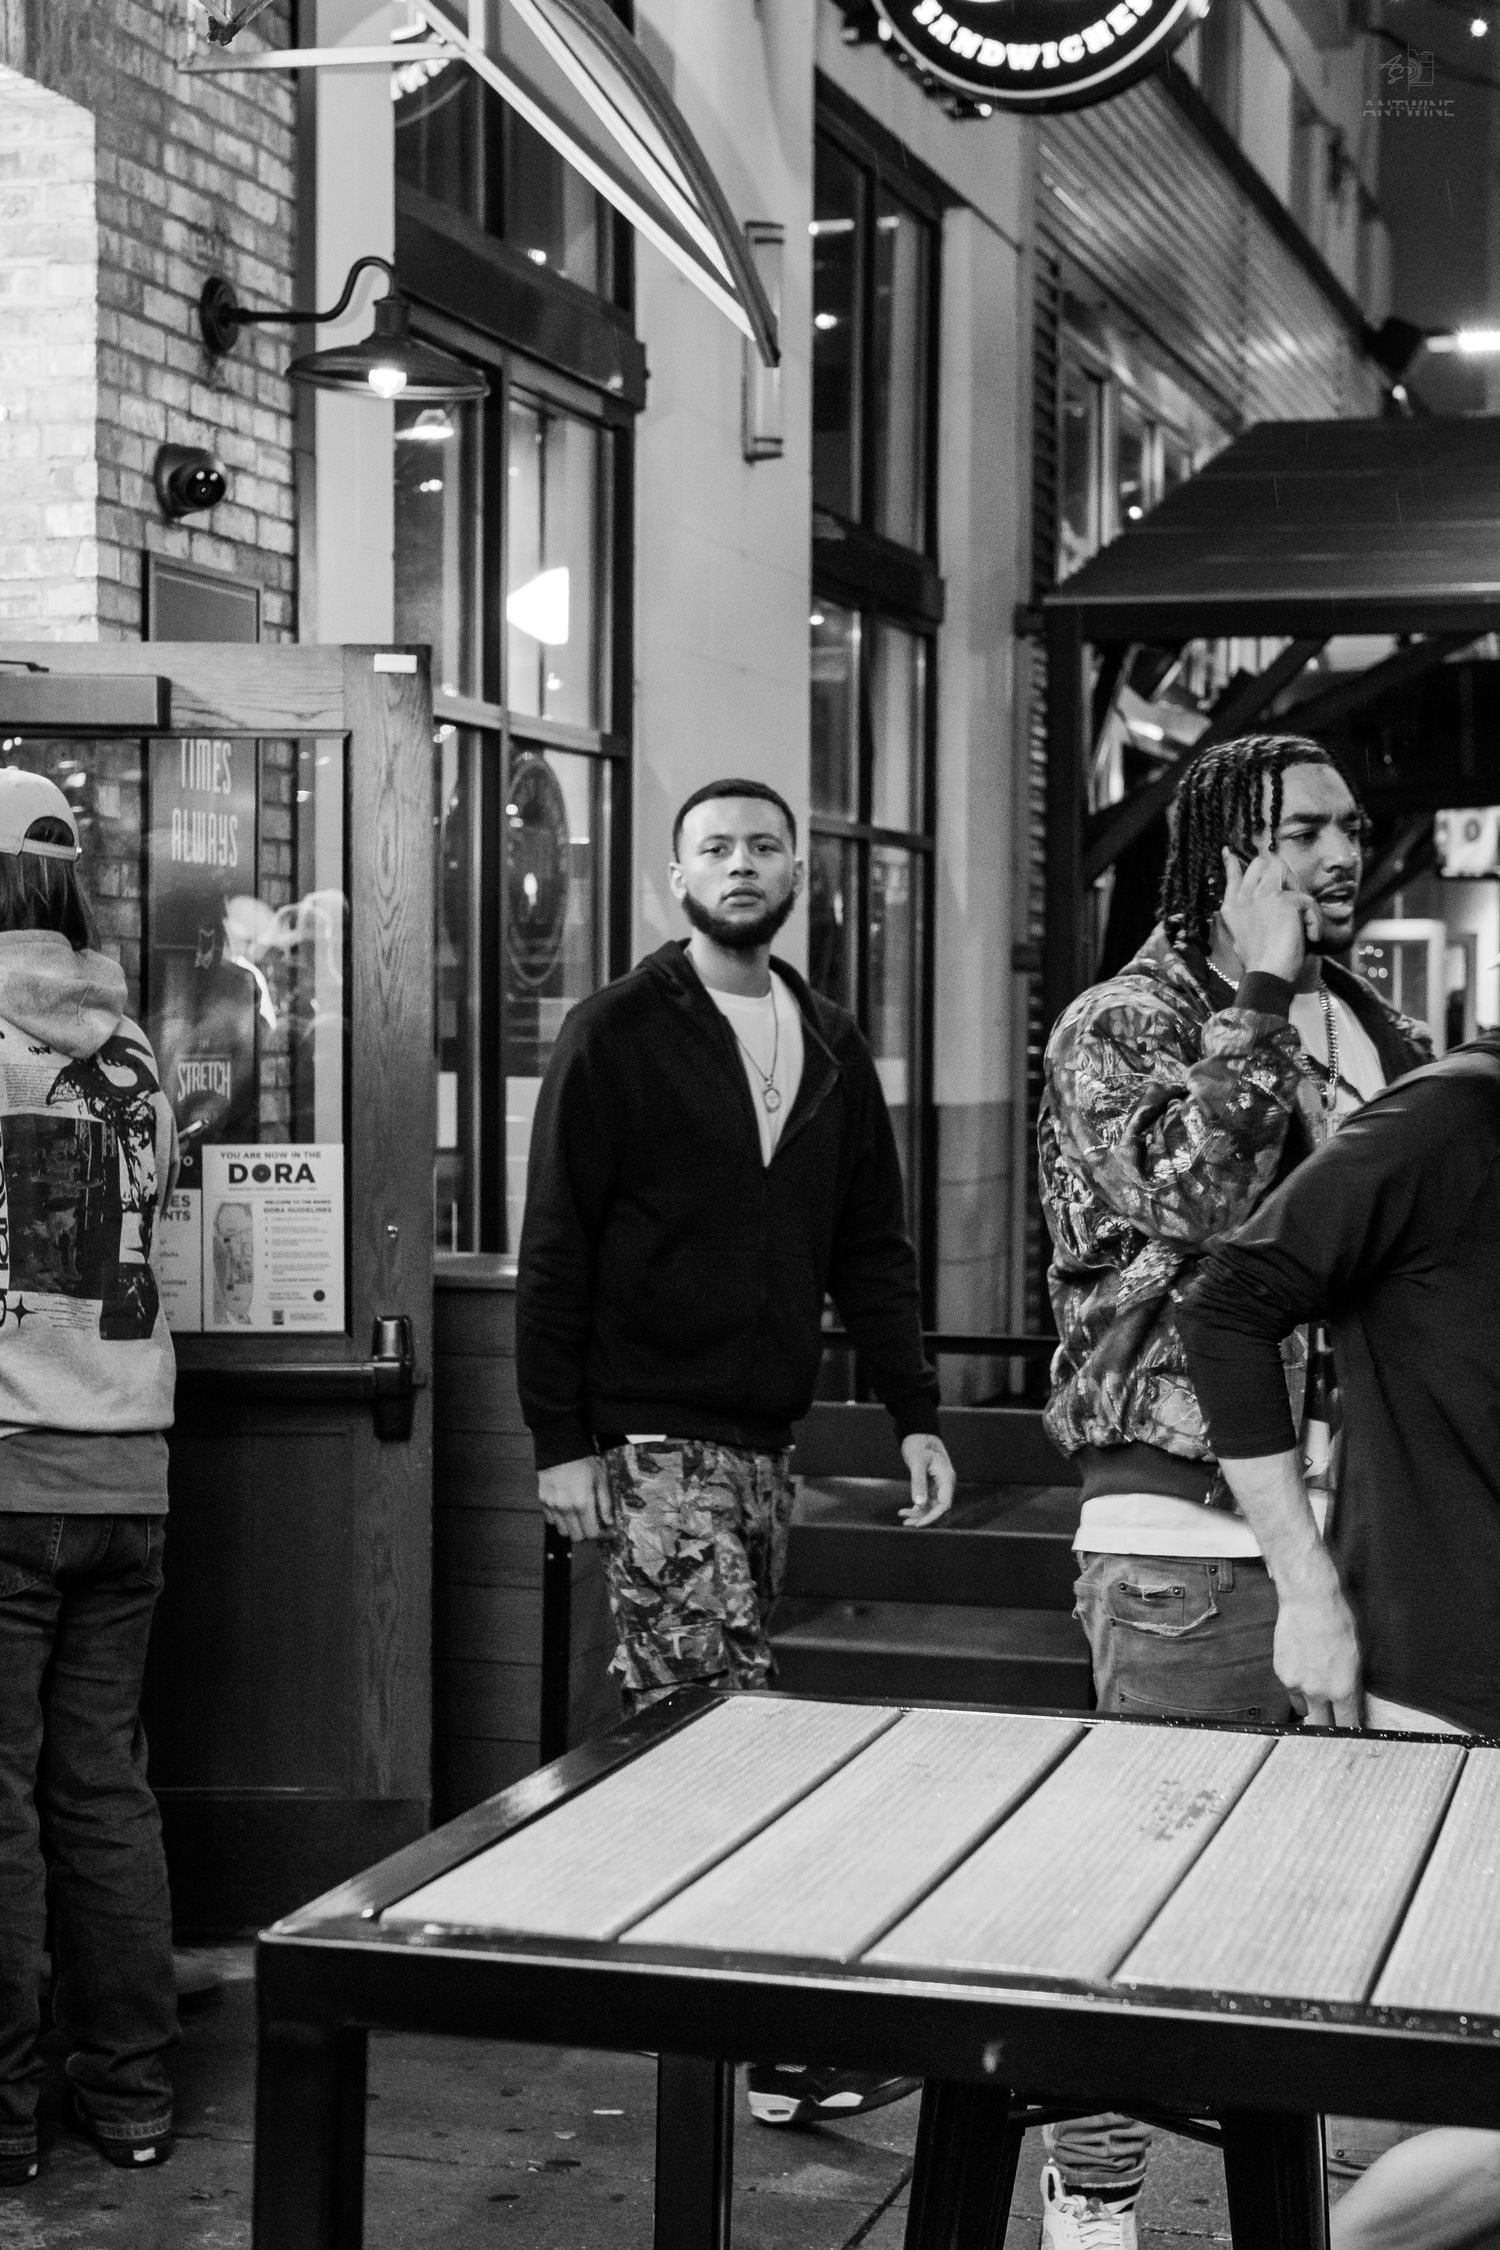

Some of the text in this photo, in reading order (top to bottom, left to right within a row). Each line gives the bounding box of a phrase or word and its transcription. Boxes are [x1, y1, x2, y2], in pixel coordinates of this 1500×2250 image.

[181, 739, 232, 795] TIMES
[172, 808, 238, 867] ALWAYS
[177, 1061, 231, 1103] STRETCH
[221, 1151, 322, 1160] YOU ARE NOW IN THE
[228, 1162, 316, 1184] DORA
